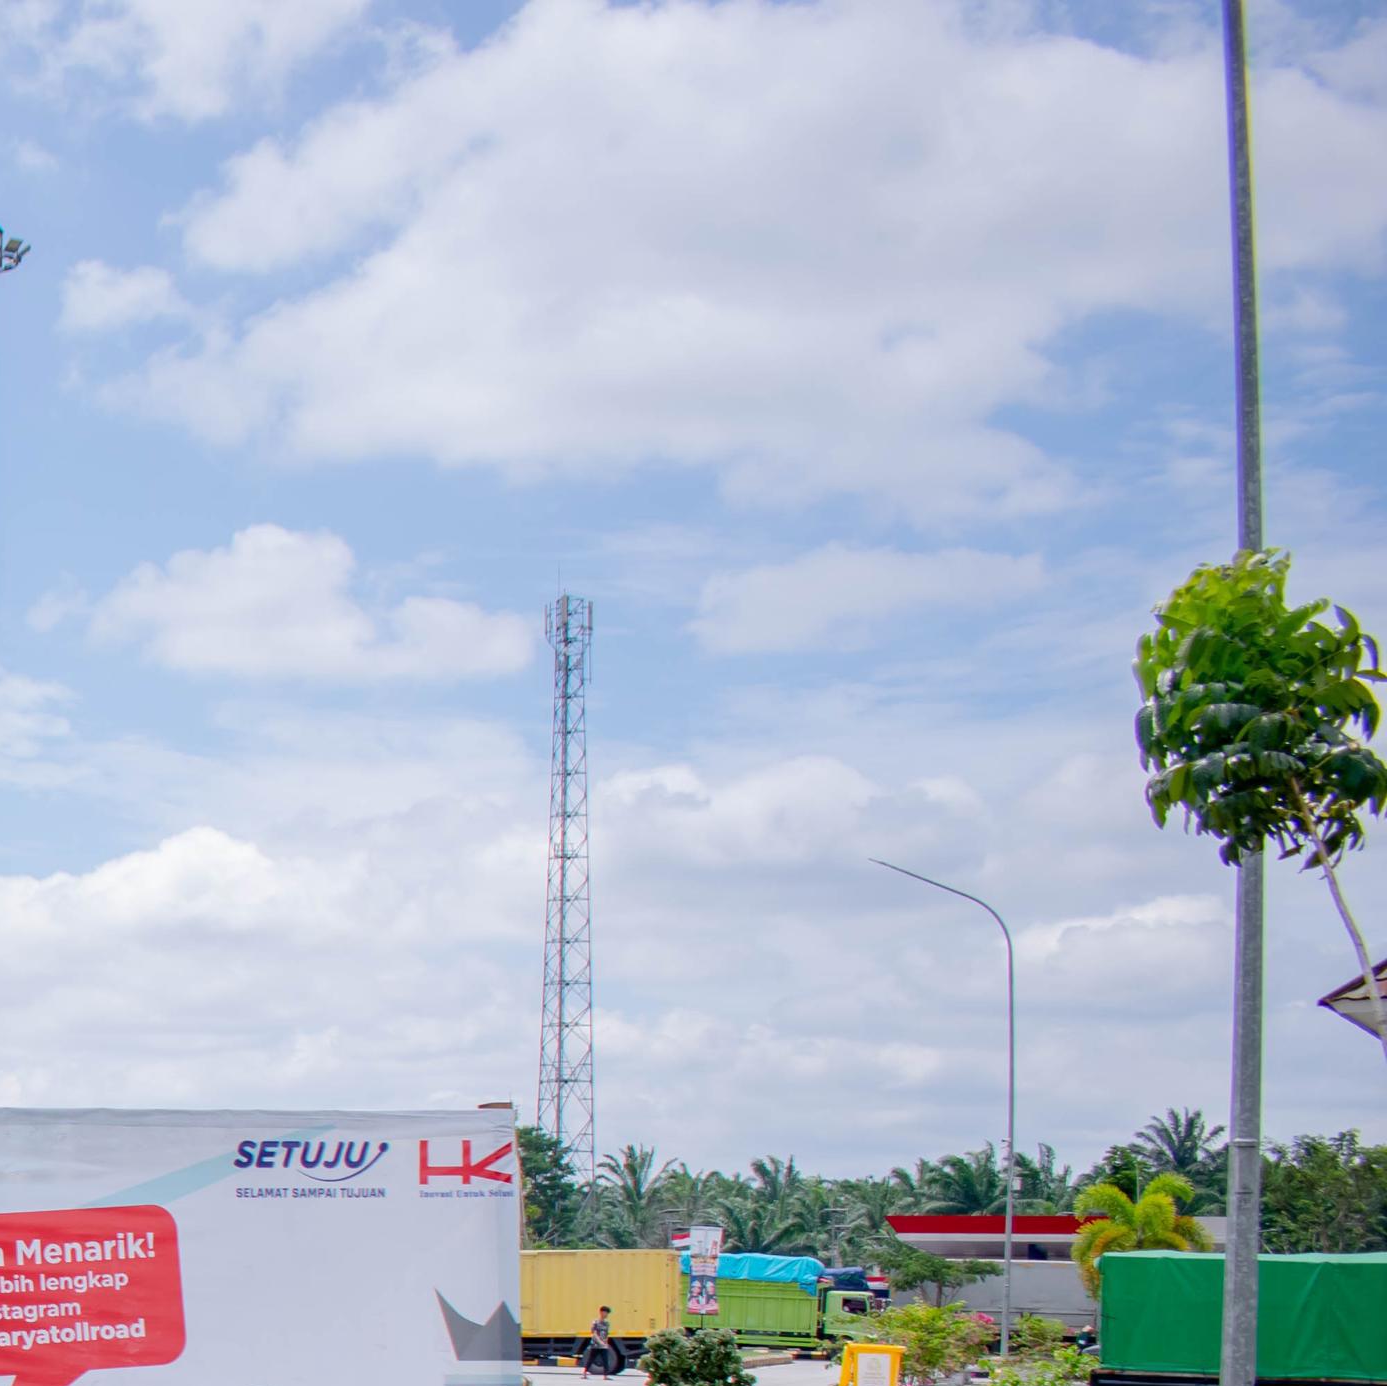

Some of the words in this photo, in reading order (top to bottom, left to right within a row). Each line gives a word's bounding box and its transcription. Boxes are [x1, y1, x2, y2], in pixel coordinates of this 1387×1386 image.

[234, 1140, 370, 1169] SETUJU
[236, 1188, 287, 1198] SELAMAT
[292, 1188, 337, 1198] SAMPAI
[340, 1188, 385, 1198] TUJUAN
[15, 1231, 155, 1266] Menarik!
[40, 1270, 129, 1293] lengkap
